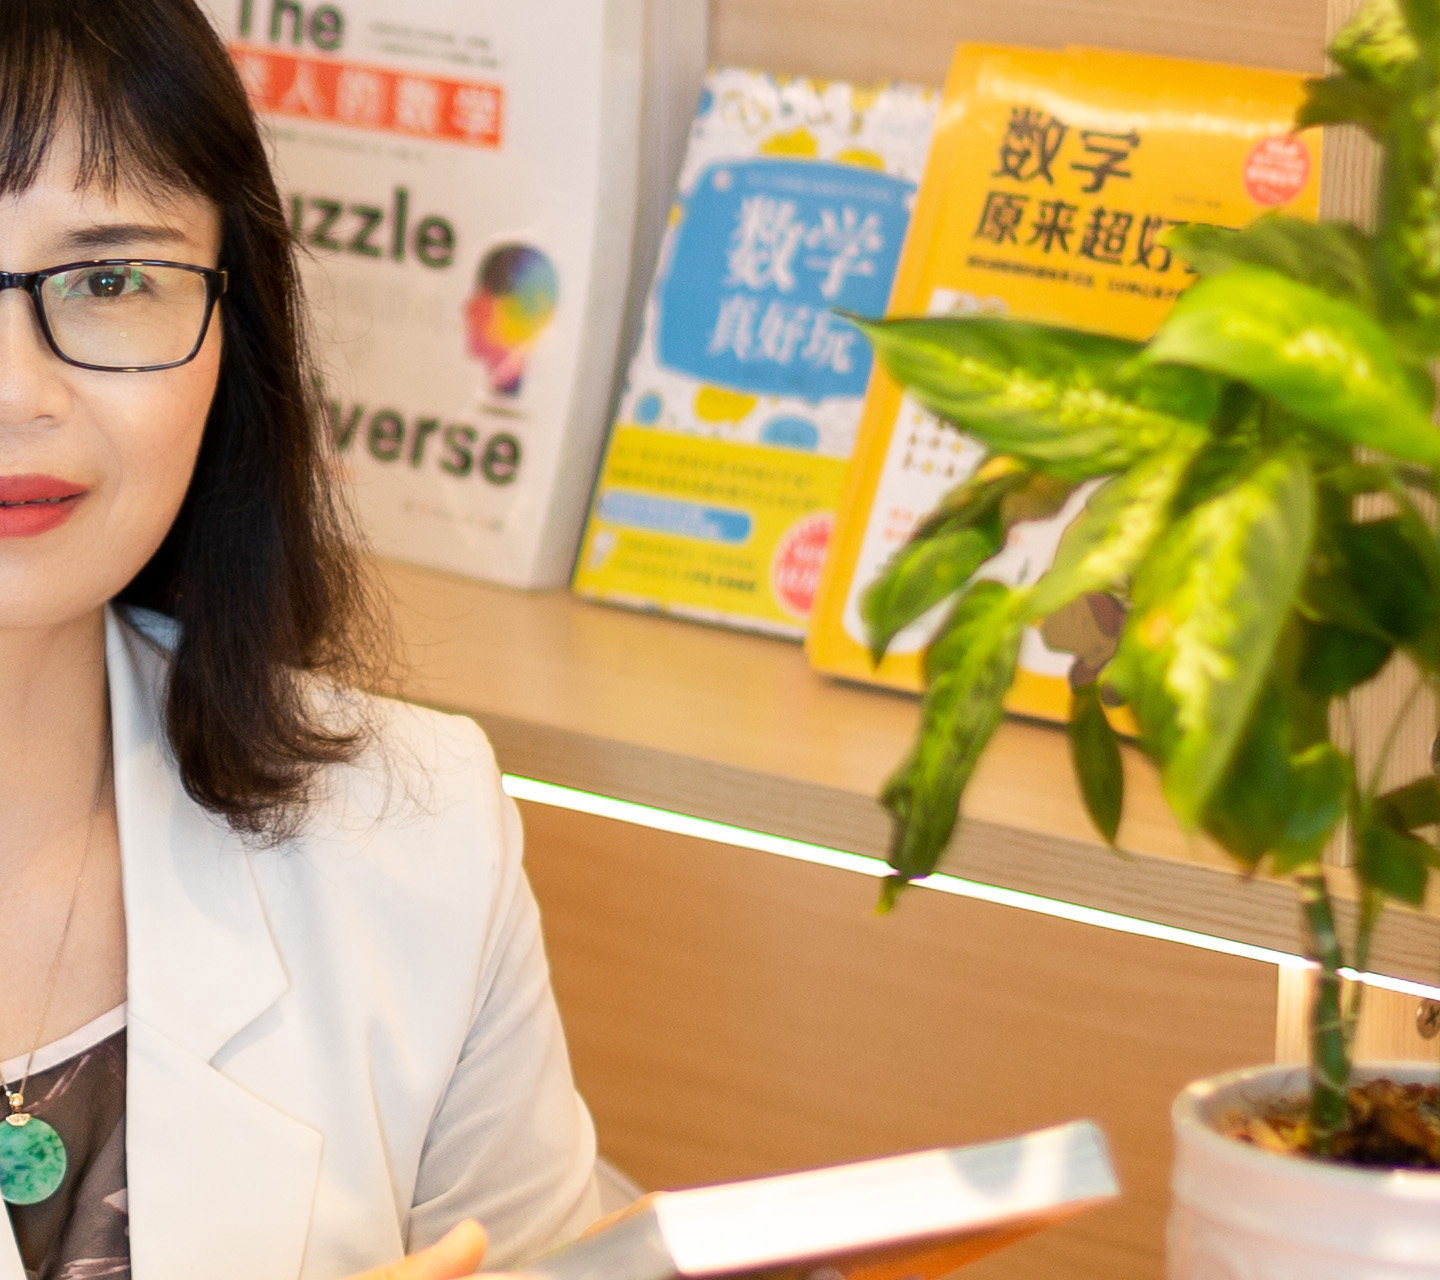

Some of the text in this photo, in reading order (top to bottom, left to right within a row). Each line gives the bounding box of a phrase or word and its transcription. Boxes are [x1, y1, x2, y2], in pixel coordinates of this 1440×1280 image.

[992, 105, 1141, 195] 数字
[291, 184, 457, 270] zzle
[726, 192, 883, 298] 数学
[973, 190, 1200, 275] 原来超好
[706, 291, 855, 375] 真好玩
[316, 398, 524, 487] verse
